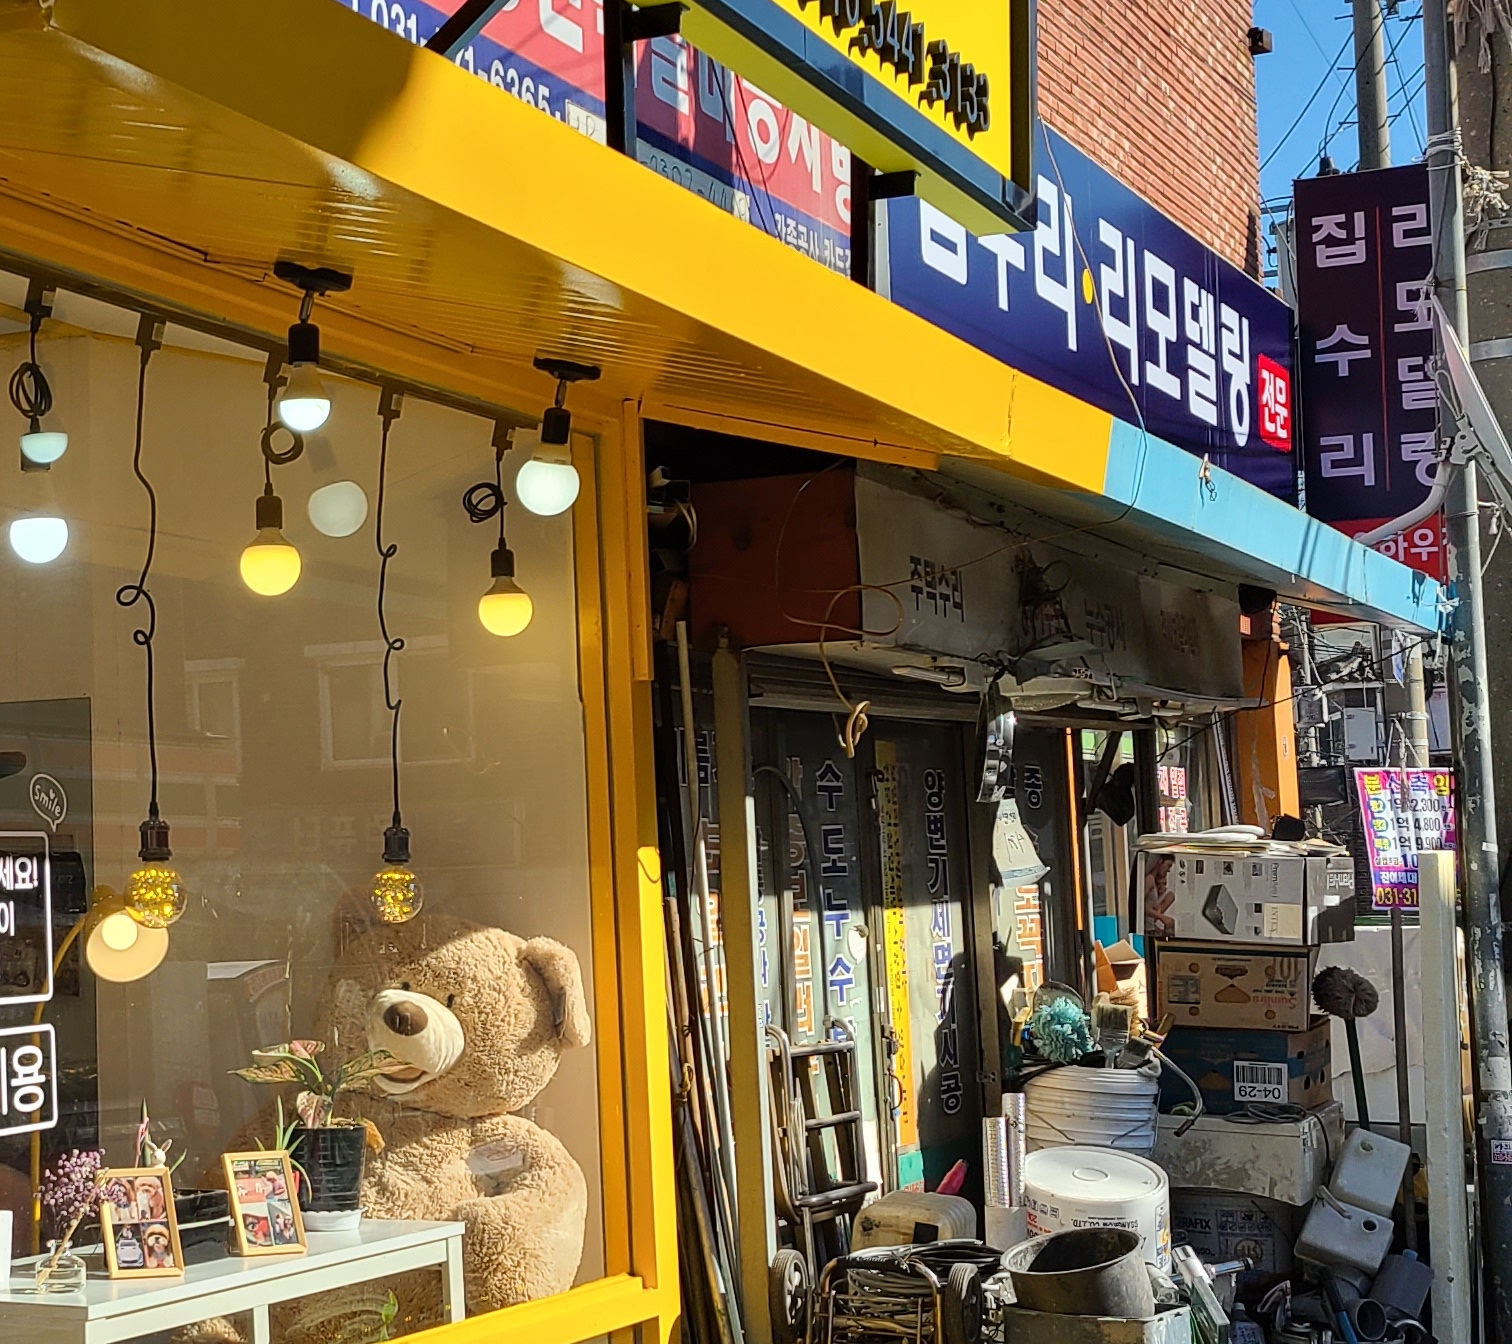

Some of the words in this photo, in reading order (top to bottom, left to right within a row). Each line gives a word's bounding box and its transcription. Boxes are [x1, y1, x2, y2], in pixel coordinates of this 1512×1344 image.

[1311, 211, 1376, 487] 집수리
[1261, 368, 1288, 439] 전문
[33, 785, 62, 818] Smile
[1238, 1085, 1281, 1099] 04-29
